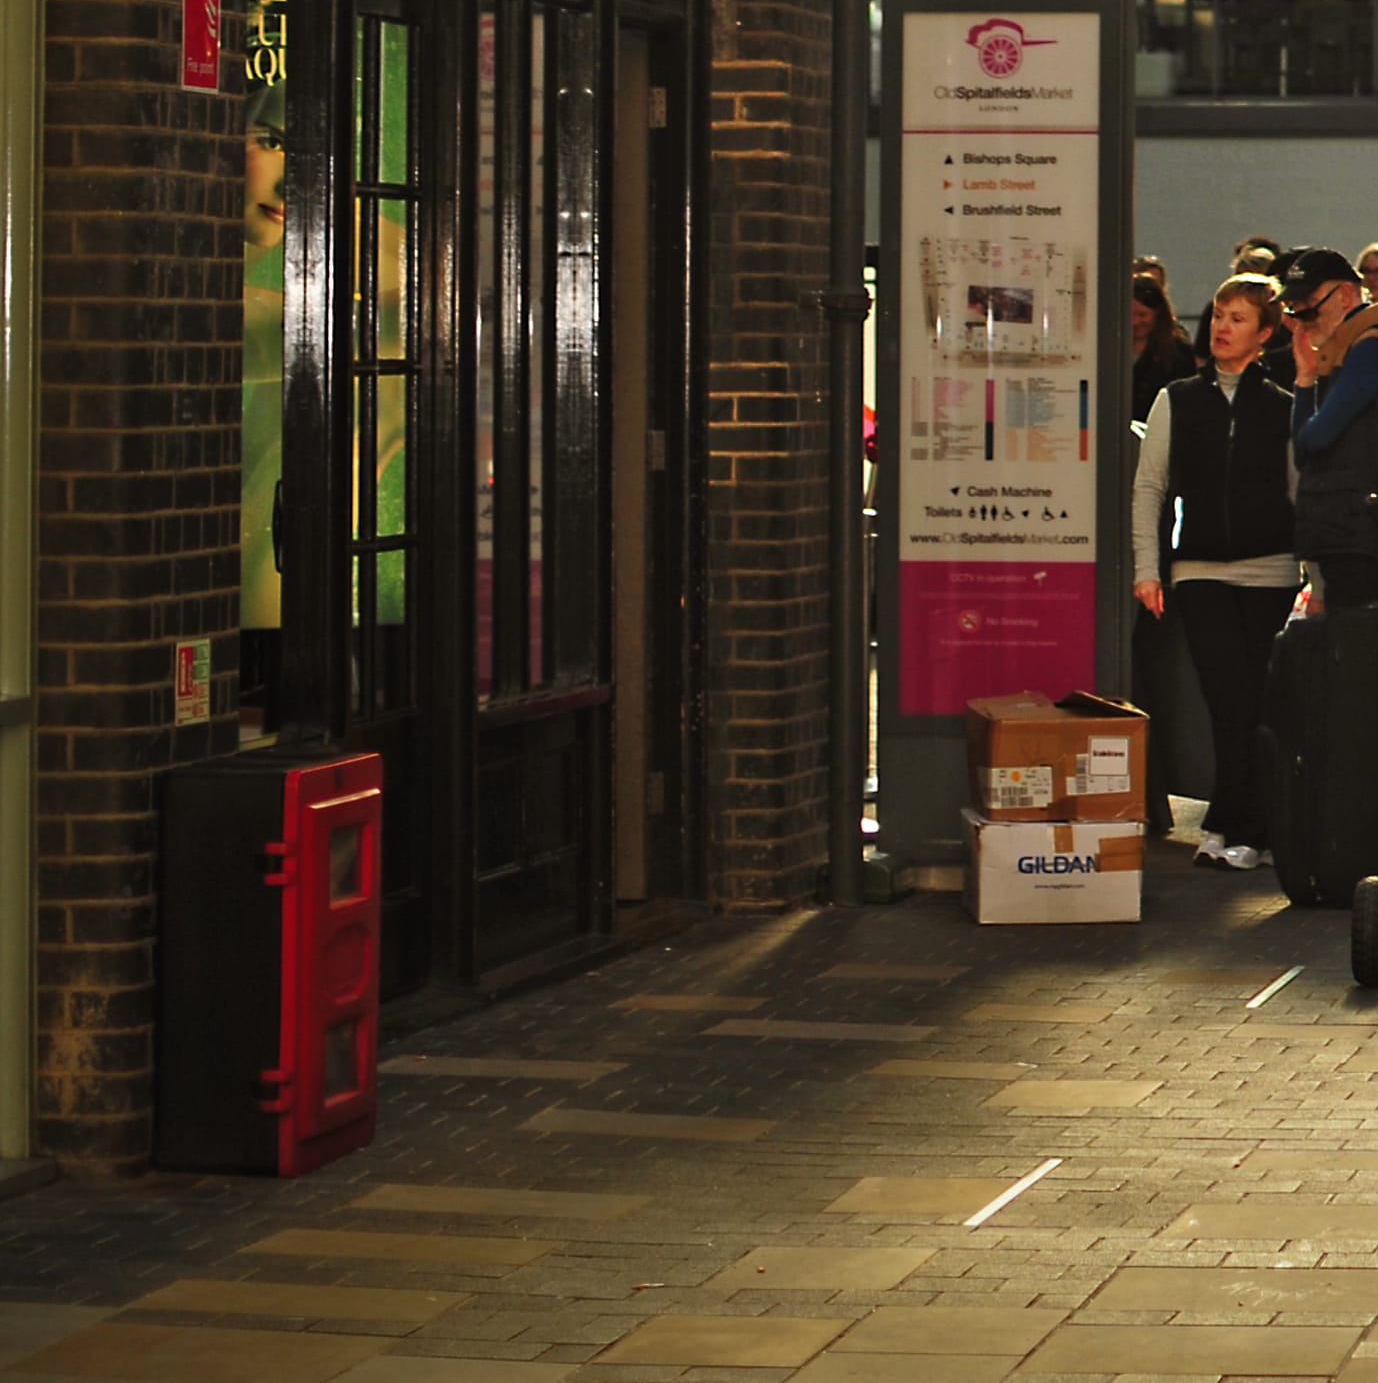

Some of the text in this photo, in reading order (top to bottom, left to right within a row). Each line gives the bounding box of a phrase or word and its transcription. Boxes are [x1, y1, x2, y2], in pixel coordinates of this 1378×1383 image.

[963, 153, 1057, 166] Bishops Square
[963, 179, 1036, 190] Lamb Street
[963, 204, 1062, 216] Brushfield Street
[967, 486, 1053, 497] Cash Machine
[924, 506, 962, 518] Toilets
[1018, 856, 1097, 875] GILDAN
